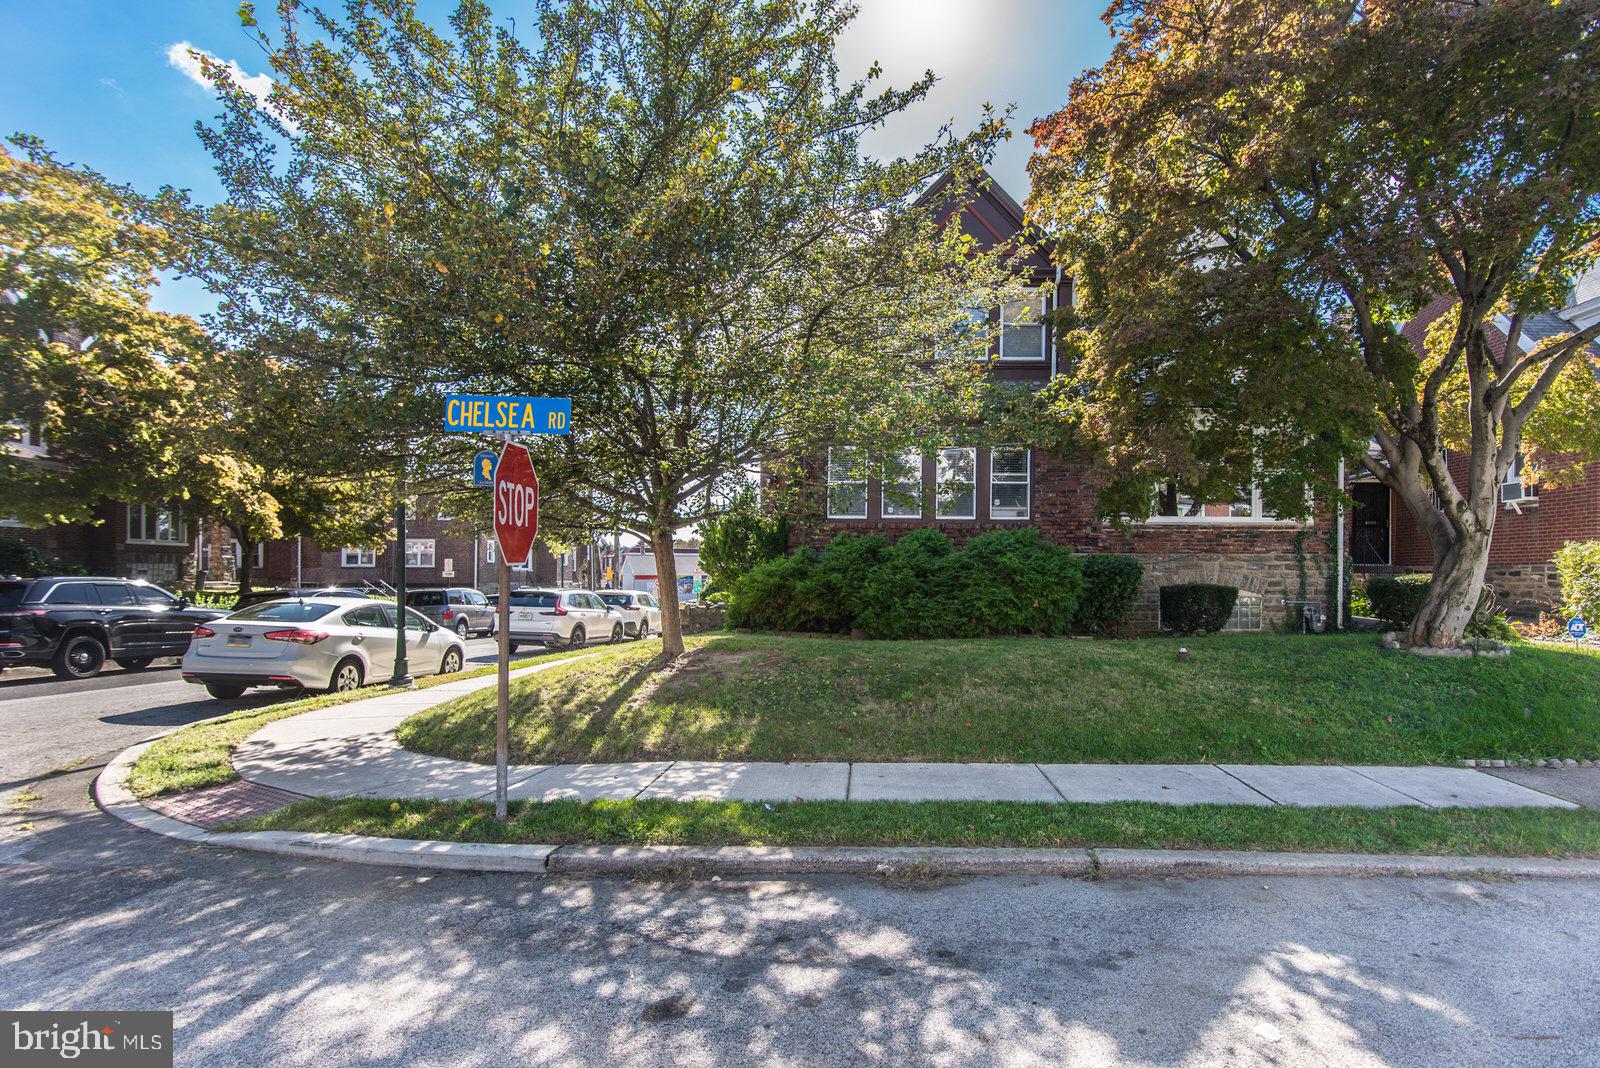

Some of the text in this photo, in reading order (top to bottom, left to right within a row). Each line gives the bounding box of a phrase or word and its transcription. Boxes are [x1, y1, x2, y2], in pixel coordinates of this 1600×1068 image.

[447, 399, 566, 430] CHELSEA RD
[498, 479, 535, 528] STOP
[1570, 623, 1585, 632] ADT
